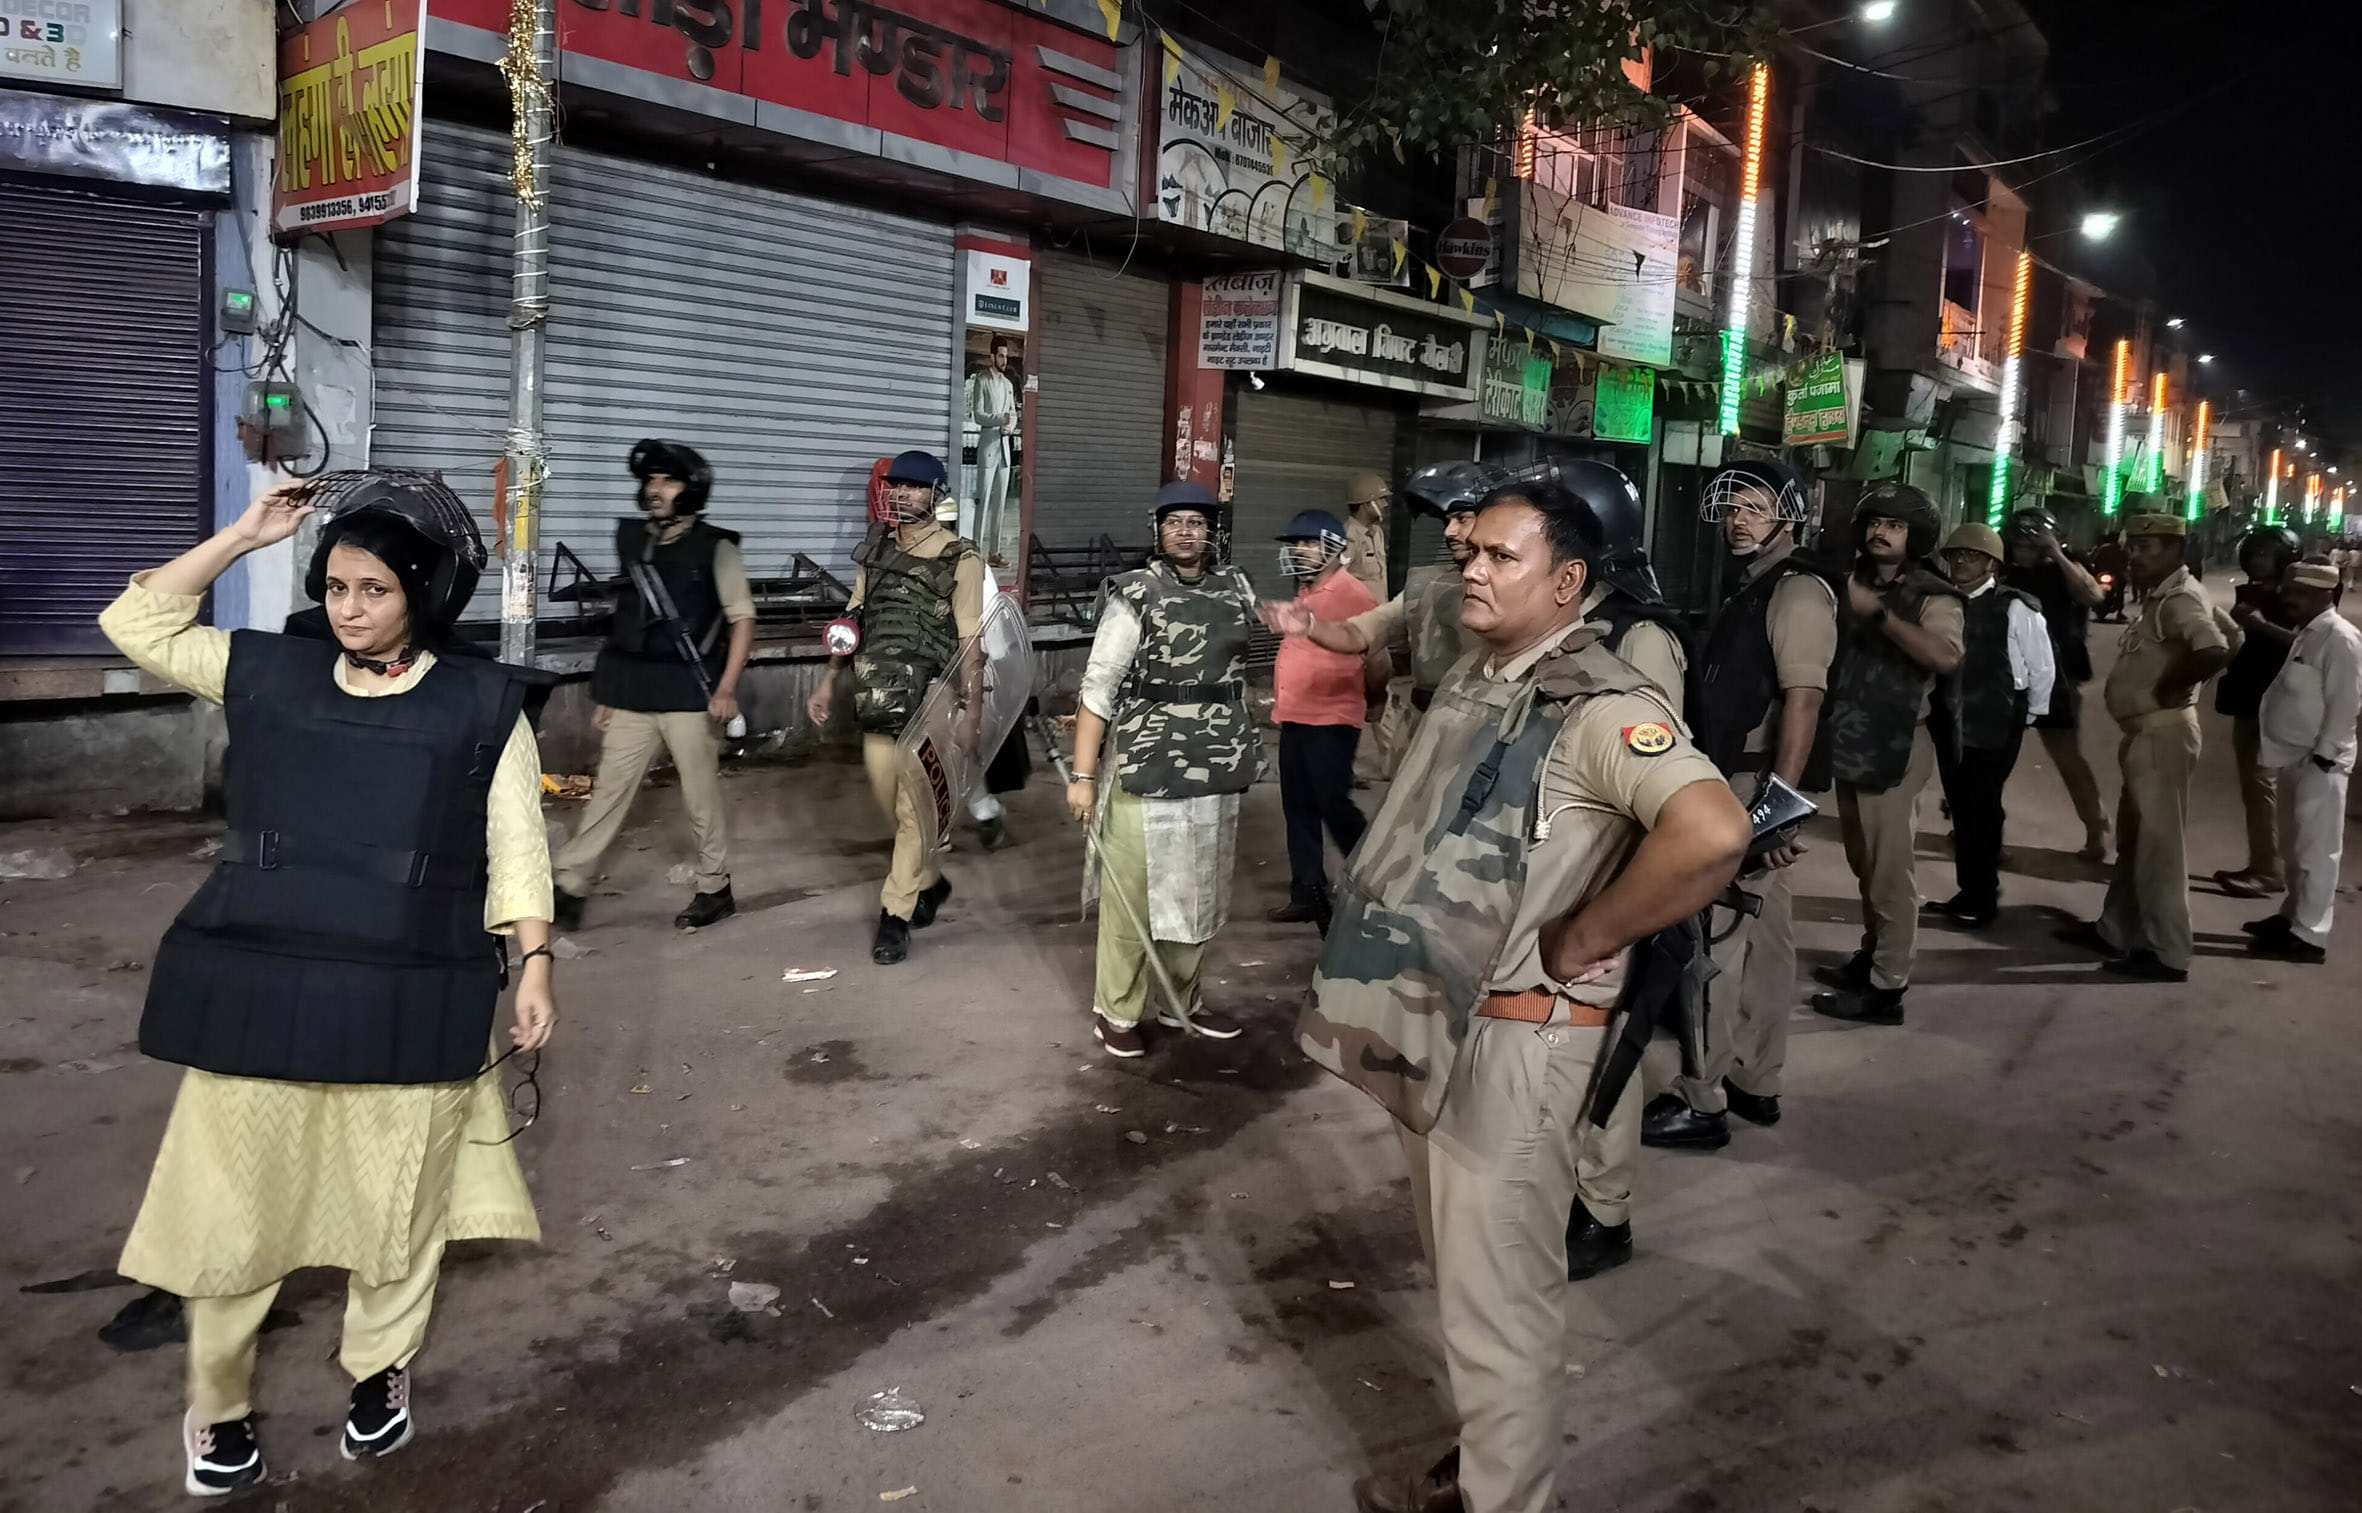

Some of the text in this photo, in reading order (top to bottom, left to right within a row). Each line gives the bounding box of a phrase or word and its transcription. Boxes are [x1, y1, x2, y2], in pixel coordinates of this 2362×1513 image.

[63, 47, 81, 72] है
[1440, 241, 1490, 256] Hawkins
[920, 744, 951, 837] POLICE
[1752, 803, 1771, 825] 494
